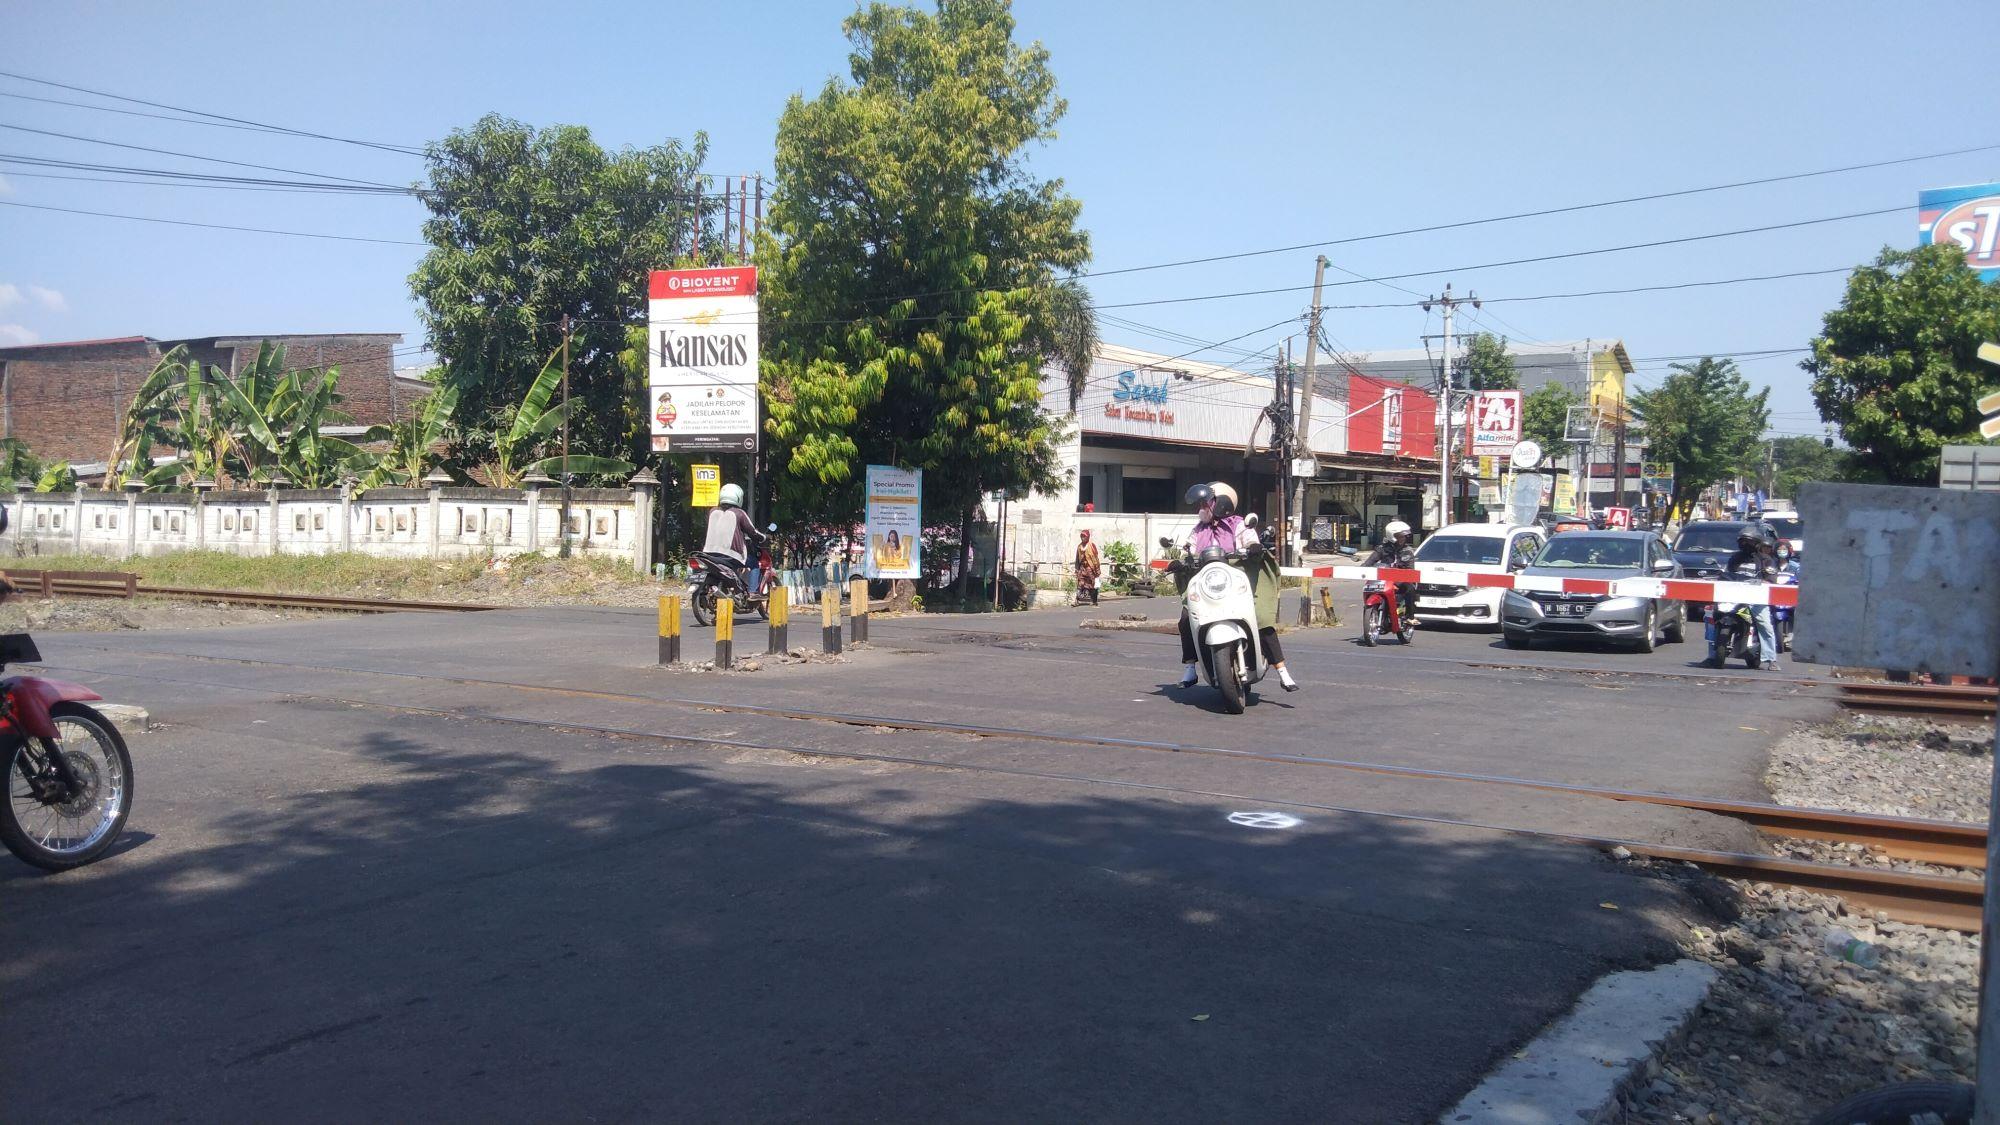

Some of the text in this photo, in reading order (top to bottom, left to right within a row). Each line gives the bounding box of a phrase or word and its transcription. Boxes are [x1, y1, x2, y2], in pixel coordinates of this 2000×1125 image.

[681, 276, 740, 288] BIOVENT
[659, 329, 748, 368] Kansas
[686, 399, 746, 408] JADILAH PELOPOR
[691, 409, 741, 417] KESELAMATAN
[1477, 434, 1514, 442] Alfamidi
[873, 481, 895, 489] Special
